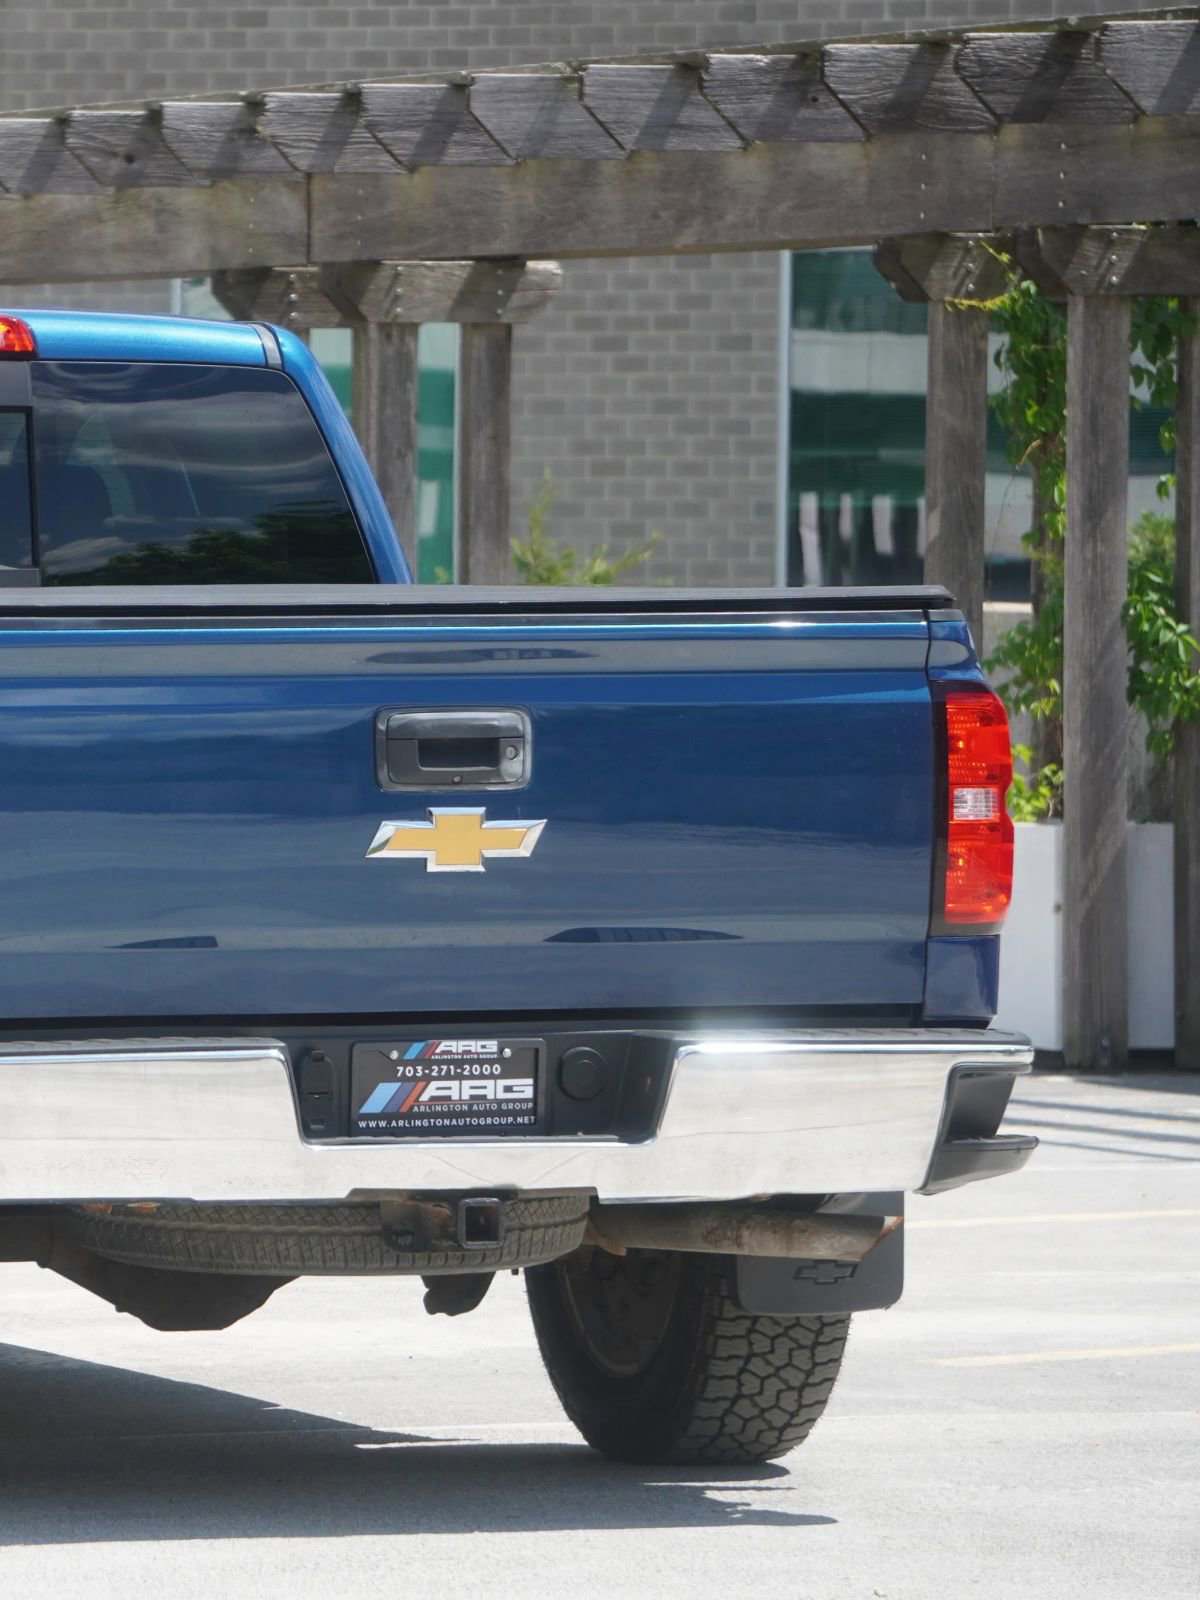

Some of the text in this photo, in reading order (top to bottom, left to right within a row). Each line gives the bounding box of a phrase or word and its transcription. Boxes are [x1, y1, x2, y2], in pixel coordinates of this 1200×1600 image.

[434, 1040, 498, 1053] AAG
[397, 1064, 501, 1077] 703-271-2000
[418, 1078, 534, 1102] AAG
[412, 1102, 533, 1113] ARLINGTON AUTO GROUP
[358, 1115, 536, 1128] WWW.ARLINGTONAUTOGROUP.NET
